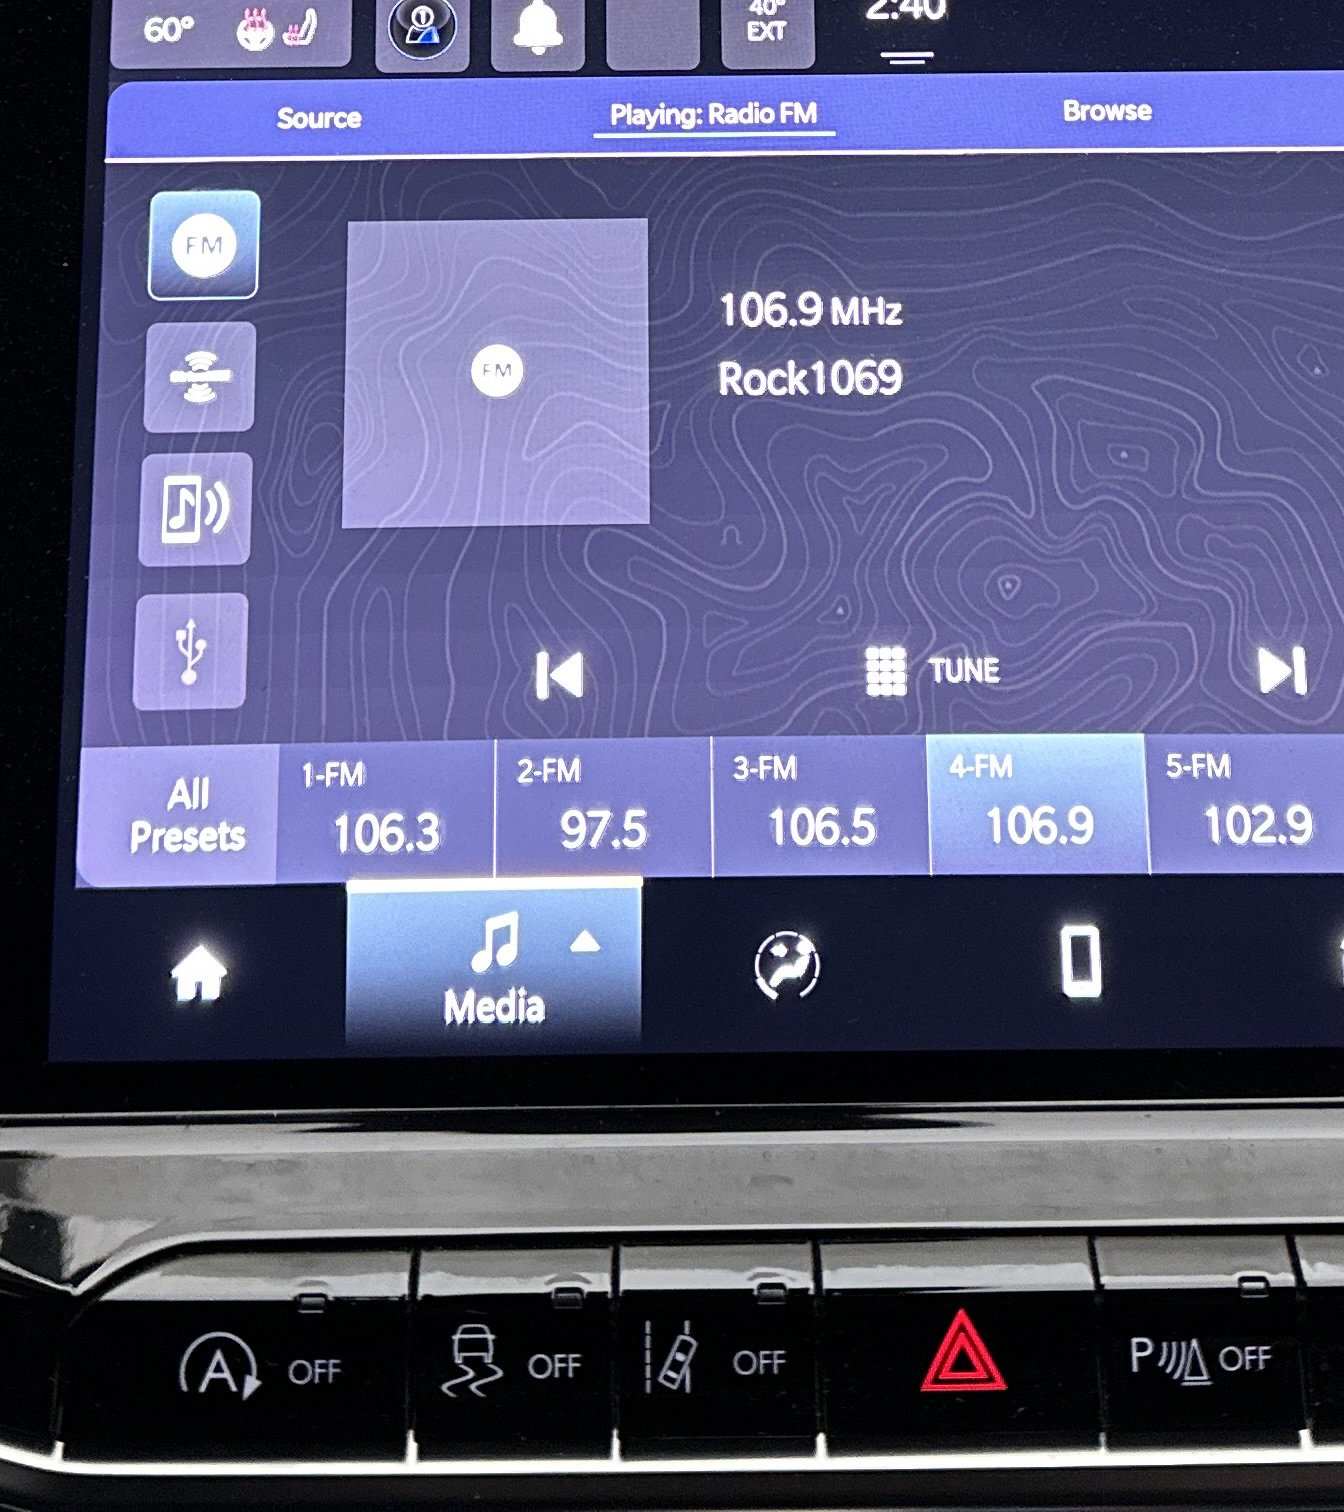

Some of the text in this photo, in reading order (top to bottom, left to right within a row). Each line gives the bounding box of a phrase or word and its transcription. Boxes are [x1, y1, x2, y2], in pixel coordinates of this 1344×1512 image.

[143, 15, 195, 44] 60°
[747, 20, 788, 42] EXT
[276, 107, 363, 130] Source
[610, 102, 818, 129] Playing: Radio FM
[1062, 99, 1154, 124] Browse
[185, 236, 223, 255] FM
[719, 290, 904, 328] 106.9 MHz
[483, 363, 512, 378] FM
[718, 358, 904, 396] Rock1069
[927, 654, 1002, 684] TUNE
[301, 759, 367, 789] 1-FM
[516, 754, 582, 785] 2-FM
[731, 752, 798, 781] 3-FM
[948, 752, 1014, 780] 4-FM
[1165, 750, 1232, 780] 5-FM
[167, 775, 210, 810] All
[130, 820, 247, 855] Presets
[334, 811, 442, 855] 106.3
[560, 808, 649, 852] 97.5
[768, 805, 878, 849] 106.5
[985, 803, 1095, 848] 106.9
[1203, 802, 1315, 847] 102.9
[443, 986, 546, 1026] Media
[288, 1359, 341, 1385] OFF
[528, 1353, 581, 1379] OFF
[733, 1350, 786, 1376] OFF
[1219, 1345, 1272, 1372] OFF
